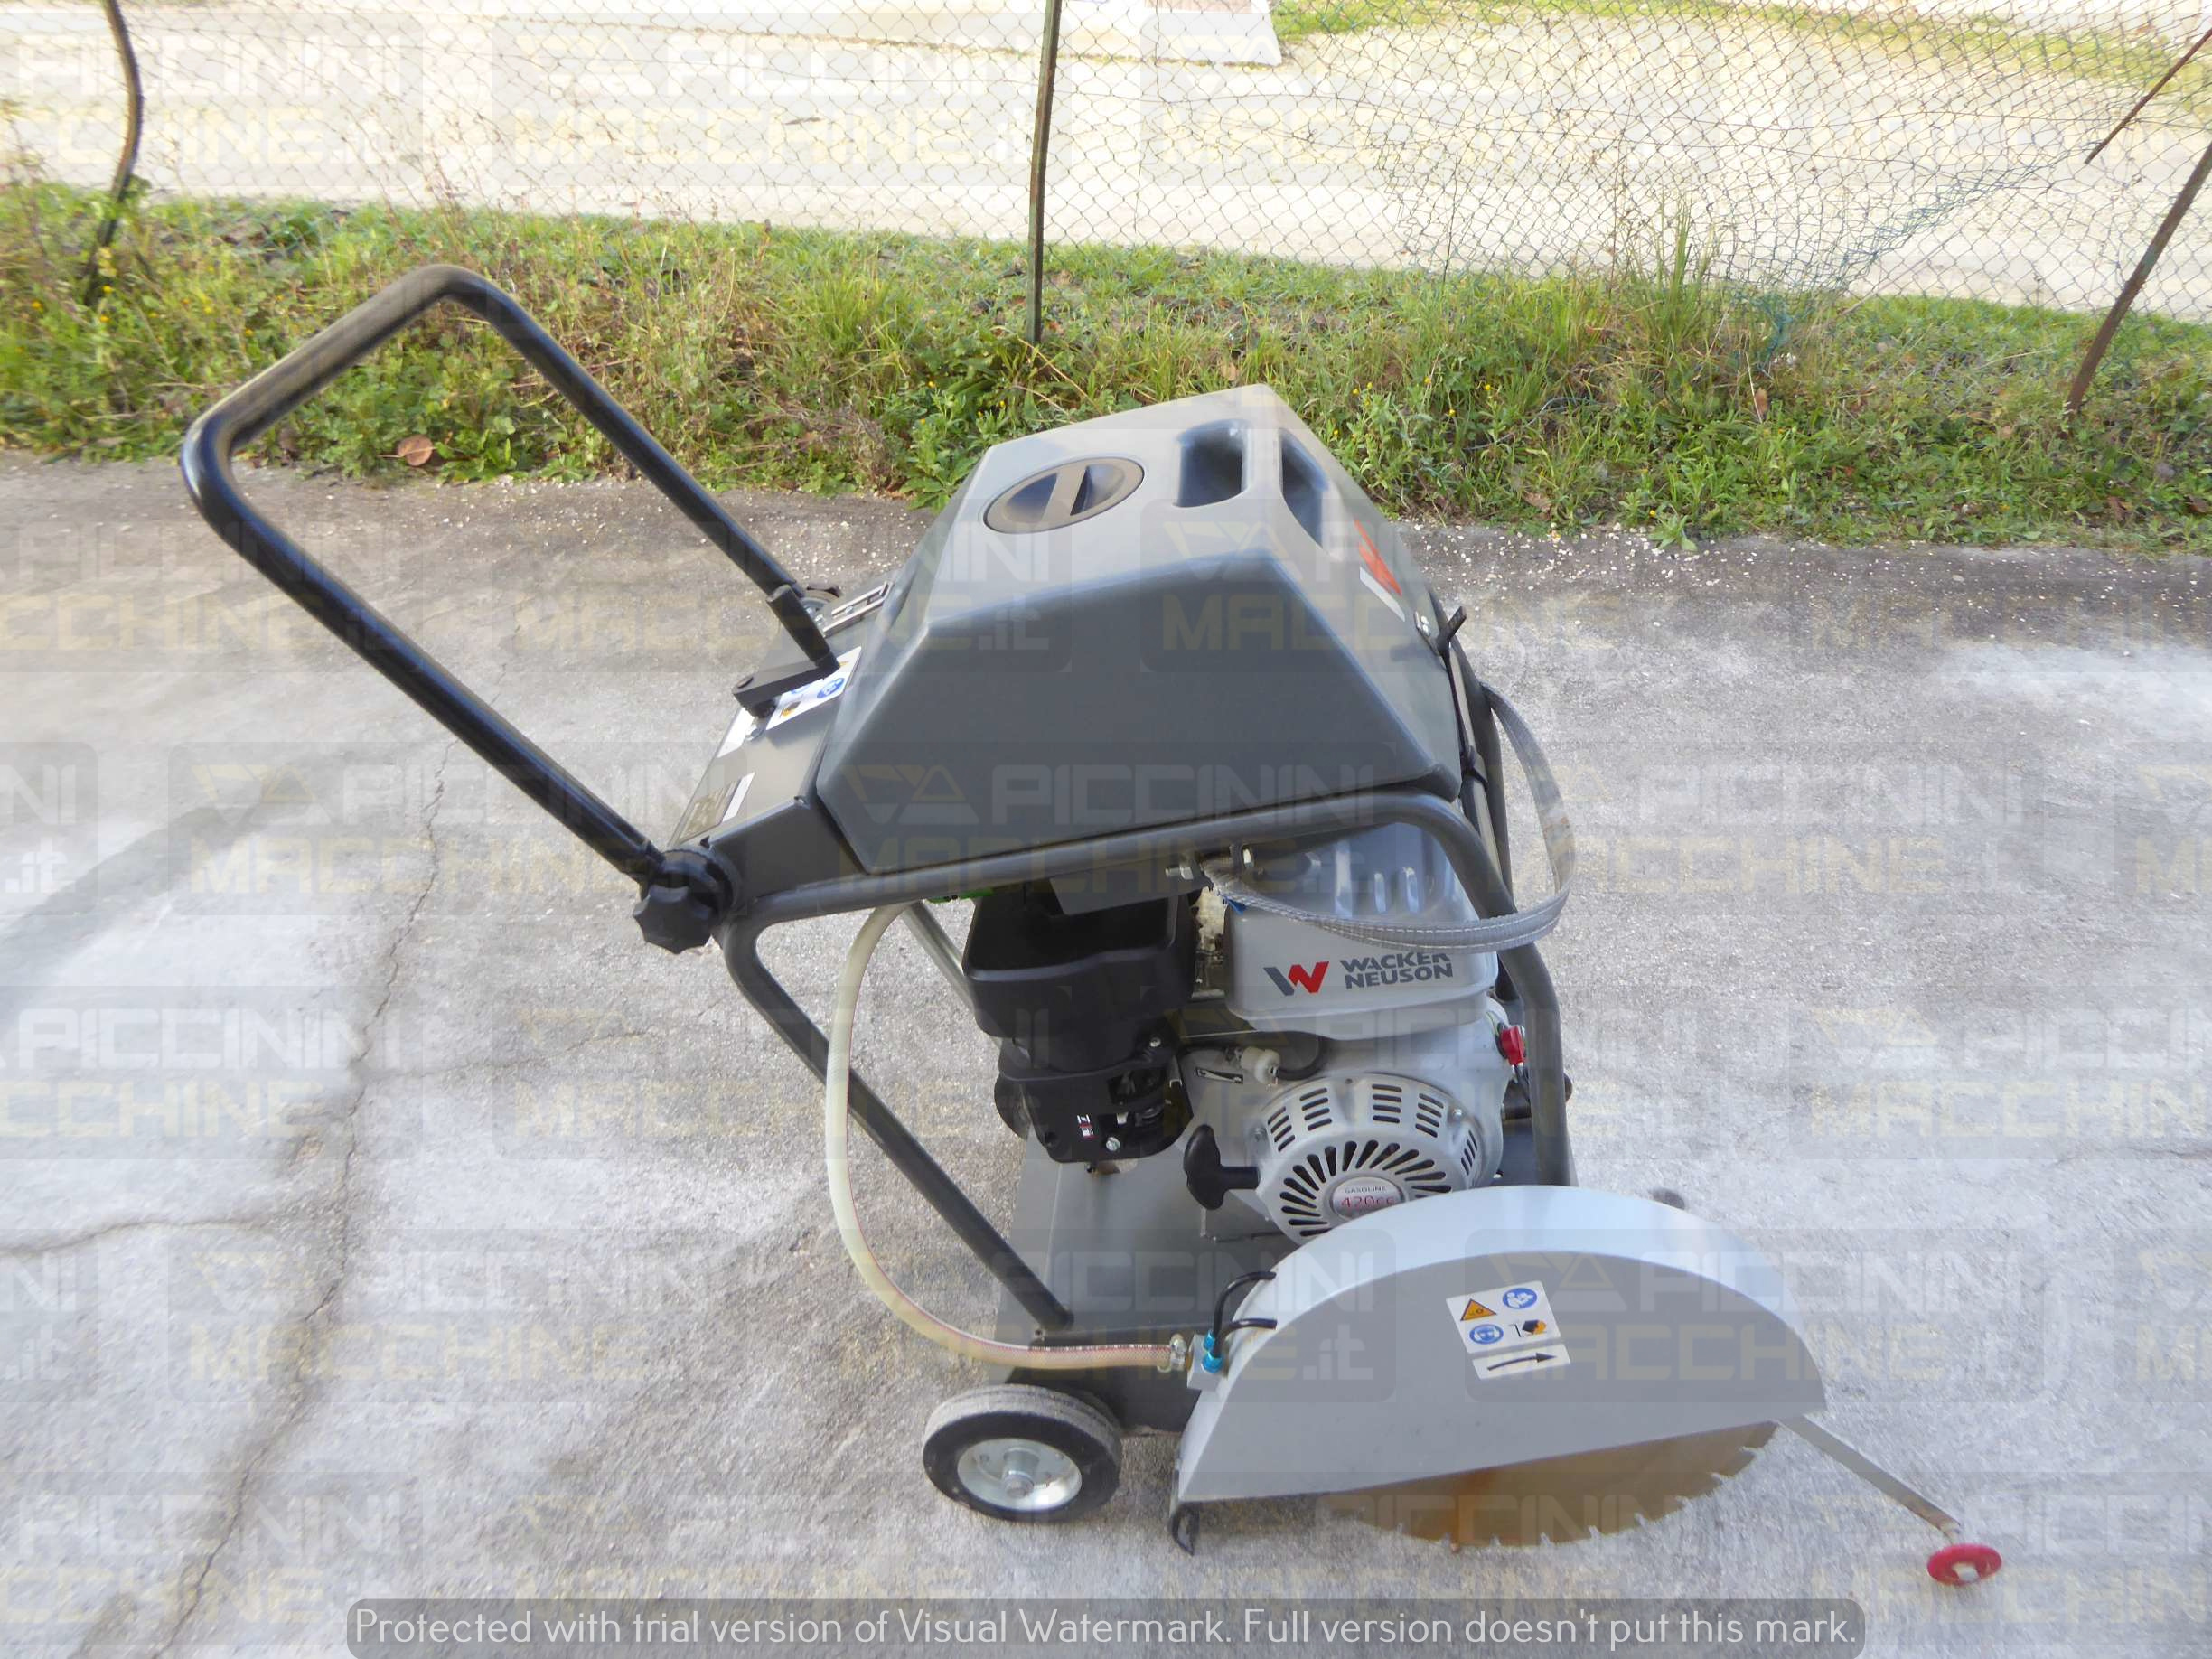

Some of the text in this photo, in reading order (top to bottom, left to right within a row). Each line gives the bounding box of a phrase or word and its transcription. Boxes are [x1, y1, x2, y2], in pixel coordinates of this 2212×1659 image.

[1339, 953, 1450, 972] WACKER
[1345, 963, 1453, 989] NEUSON
[1345, 1185, 1386, 1194] GASOLINE
